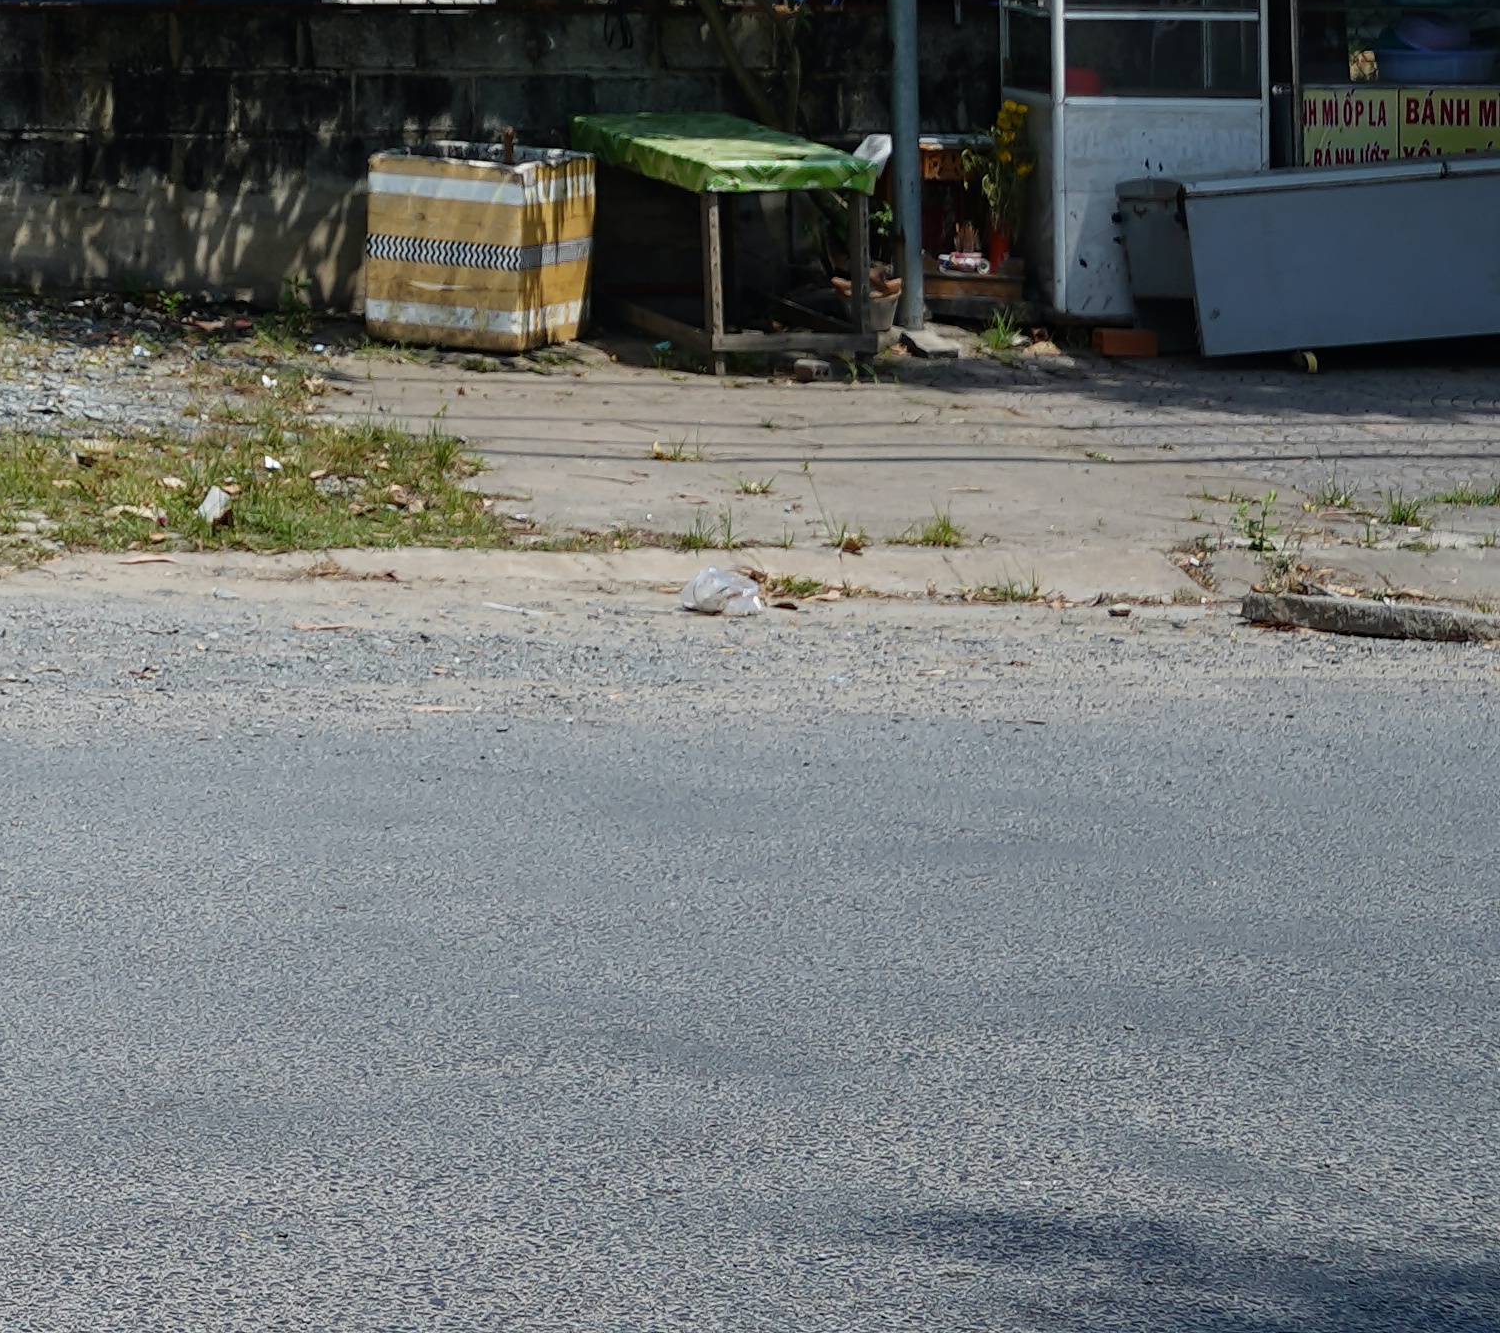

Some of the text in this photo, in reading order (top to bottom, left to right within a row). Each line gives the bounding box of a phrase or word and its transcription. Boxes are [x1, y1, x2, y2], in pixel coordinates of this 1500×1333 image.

[1321, 91, 1339, 126] MÌ
[1405, 89, 1500, 127] BÁNH M
